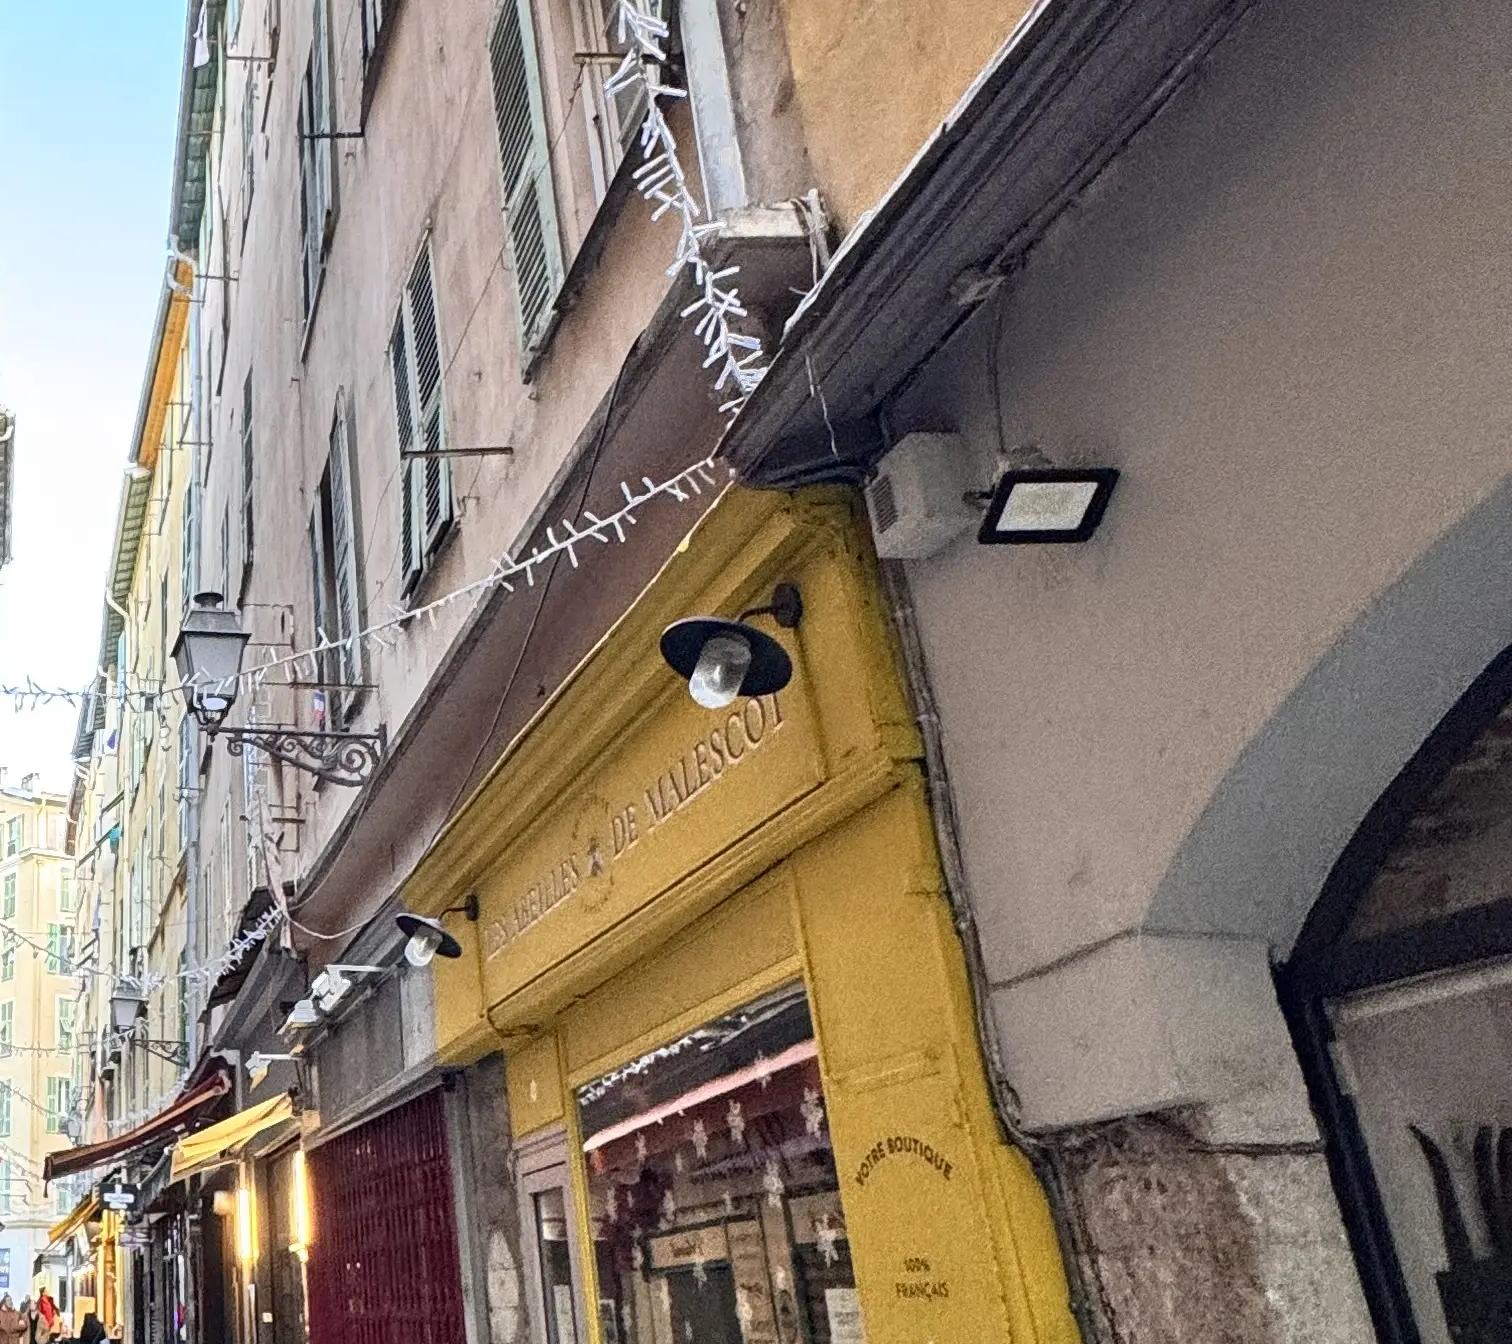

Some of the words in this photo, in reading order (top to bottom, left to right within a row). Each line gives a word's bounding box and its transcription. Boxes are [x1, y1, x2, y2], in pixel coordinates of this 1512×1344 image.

[611, 805, 639, 861] DE
[643, 692, 785, 833] MALESCOT
[855, 1142, 886, 1186] VOTRE
[887, 1136, 954, 1181] BOUTIQUE
[903, 1257, 931, 1272] 100%
[895, 1281, 949, 1303] FRANÇAIS
